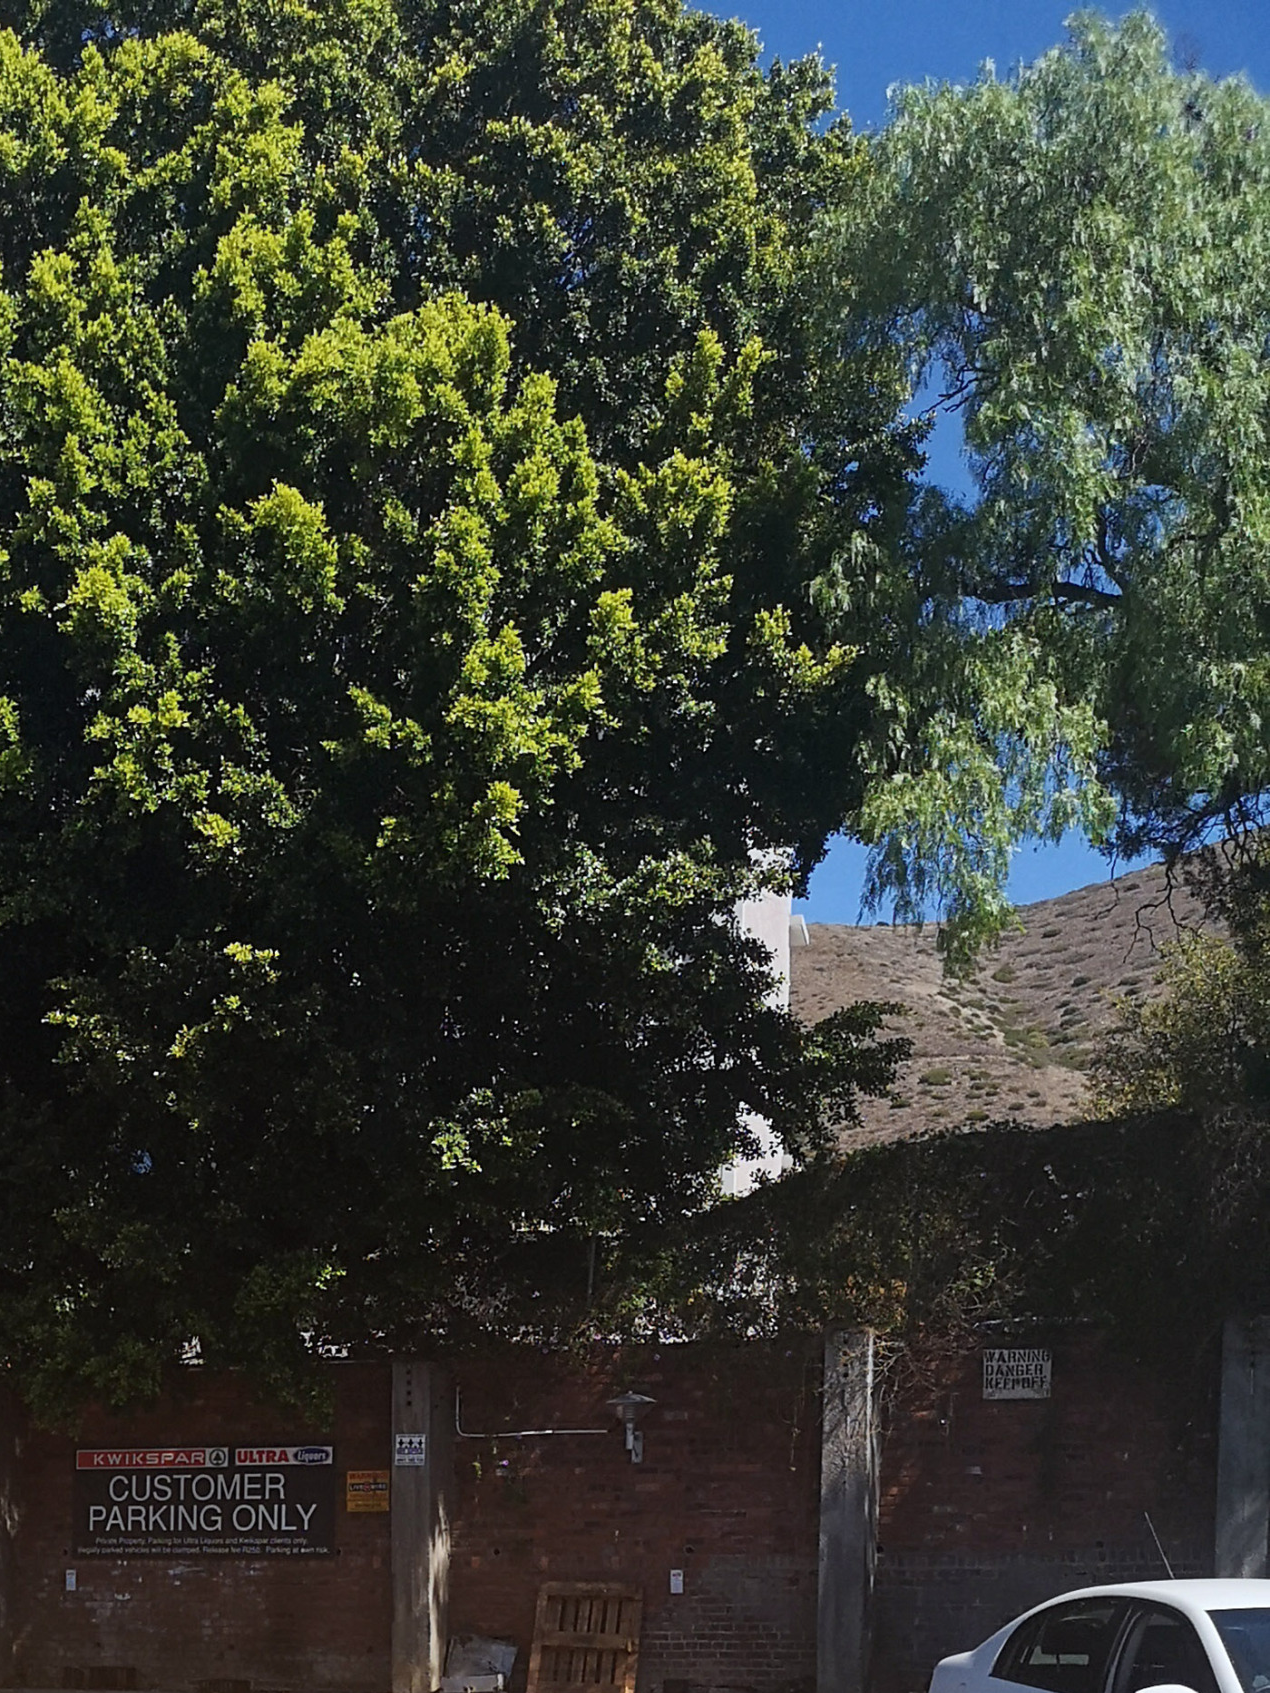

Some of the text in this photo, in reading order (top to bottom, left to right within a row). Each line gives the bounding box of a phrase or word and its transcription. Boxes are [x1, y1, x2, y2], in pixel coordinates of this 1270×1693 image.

[984, 1350, 1051, 1363] WARNING
[985, 1364, 1044, 1376] DANGER
[985, 1375, 1047, 1389] KEEP OFF
[93, 1450, 205, 1466] KWIKSPAR
[237, 1449, 327, 1464] ULTRA Liquors
[108, 1473, 286, 1501] CUSTOMER
[89, 1504, 317, 1531] PARKING ONLY
[266, 1546, 291, 1555] Parking
